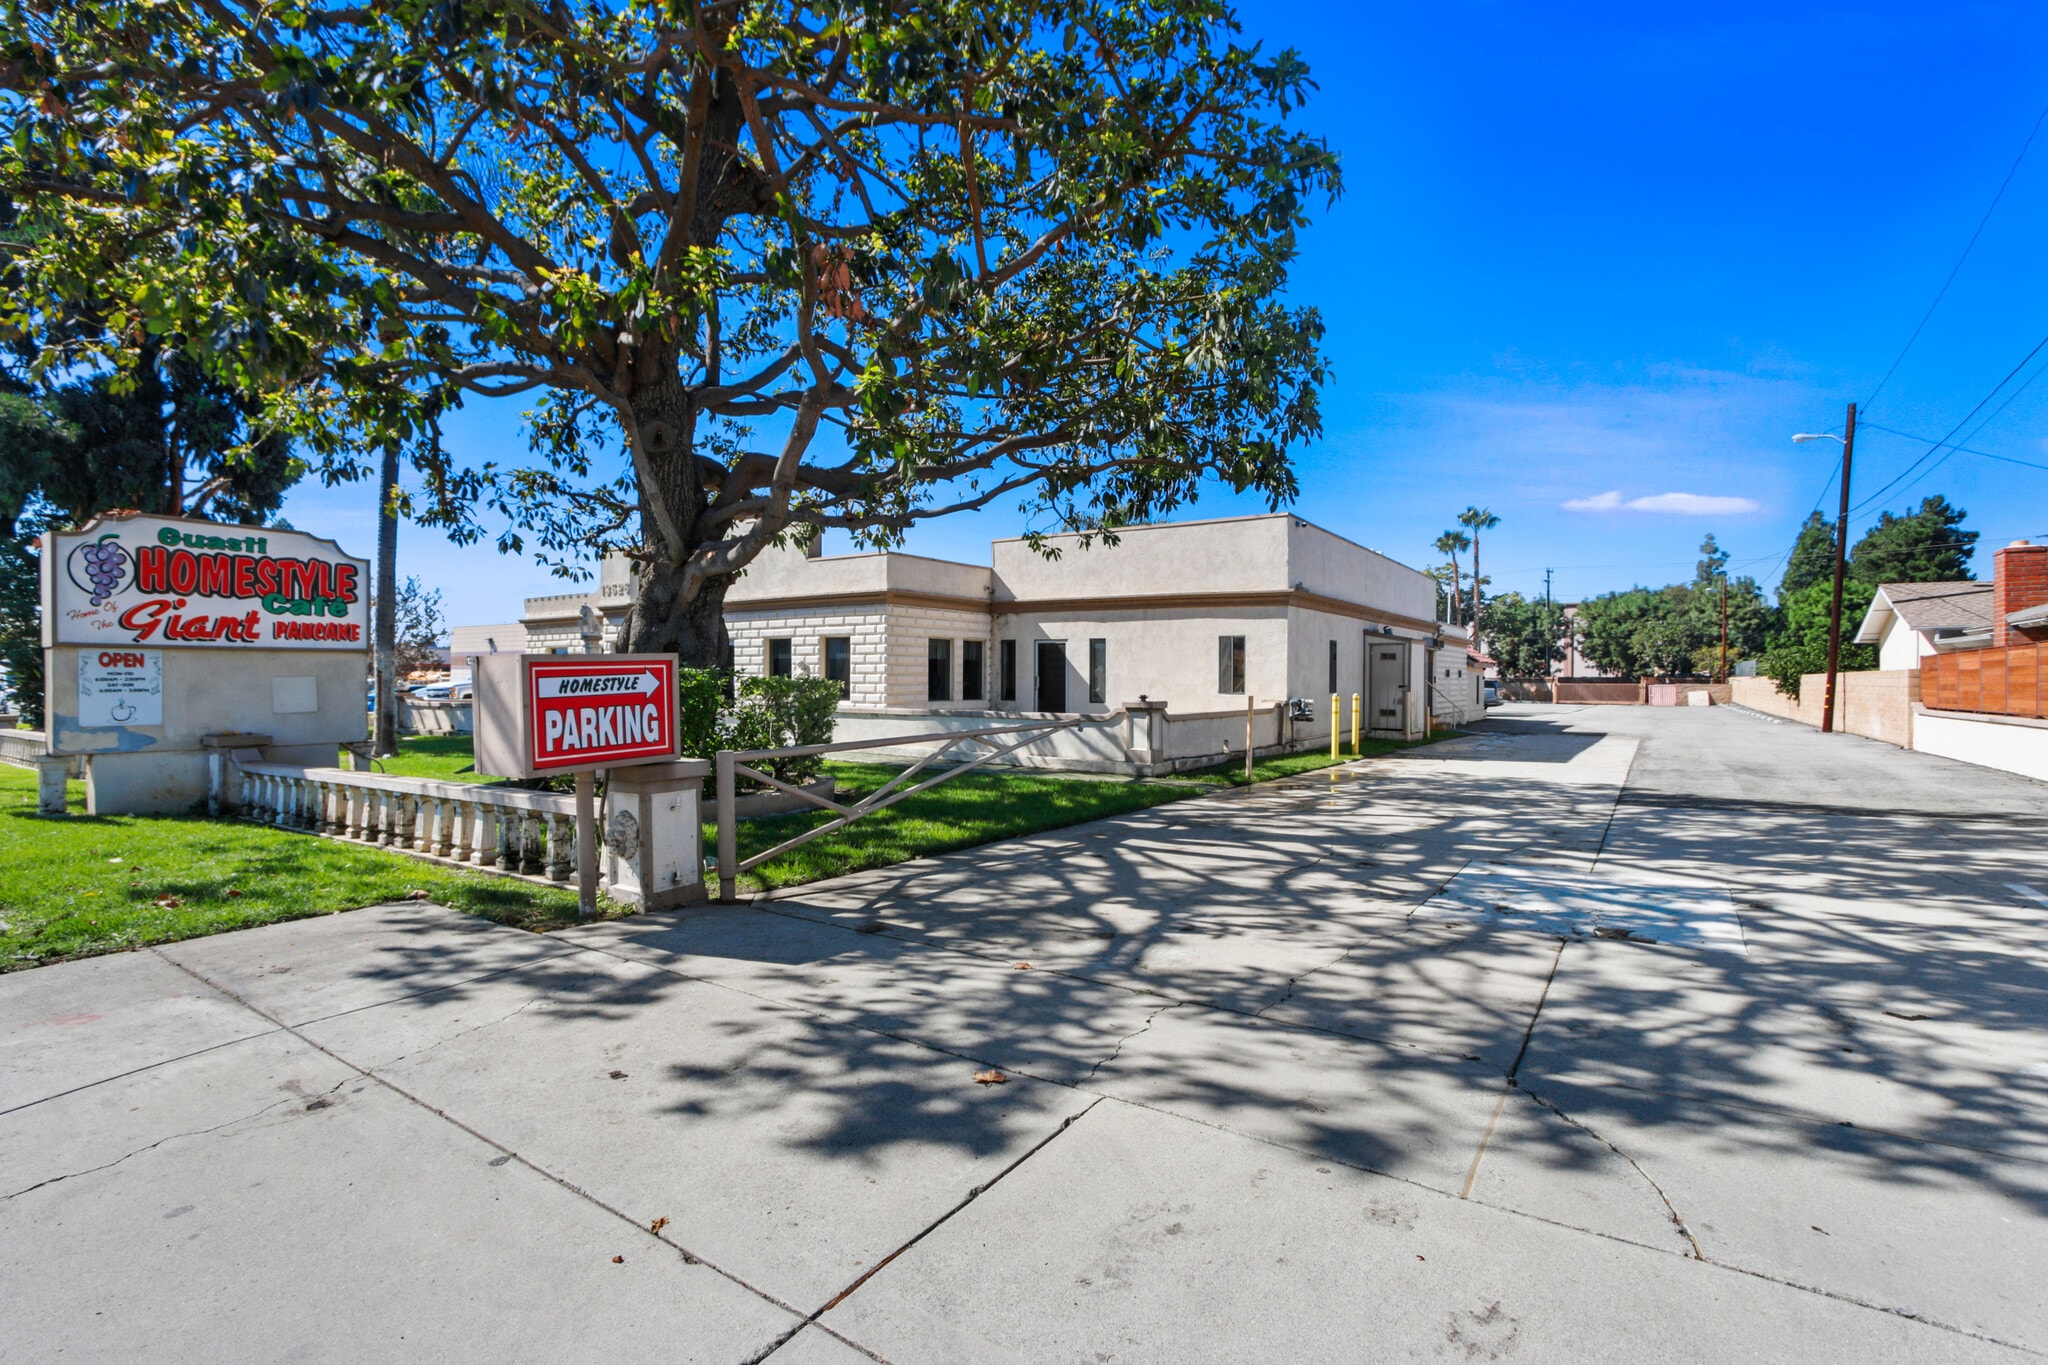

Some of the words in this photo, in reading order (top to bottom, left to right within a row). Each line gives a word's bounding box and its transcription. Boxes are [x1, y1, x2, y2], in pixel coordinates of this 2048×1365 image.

[157, 527, 268, 554] Guasti
[137, 546, 359, 603] HOMESTYLE
[66, 609, 100, 620] Home
[103, 601, 118, 613] Of
[118, 598, 261, 643] Giant
[273, 621, 361, 642] PANCAKE
[90, 619, 114, 630] The
[98, 651, 145, 668] OPEN
[559, 676, 640, 694] HOMESTYLE
[544, 702, 660, 752] PARKING
